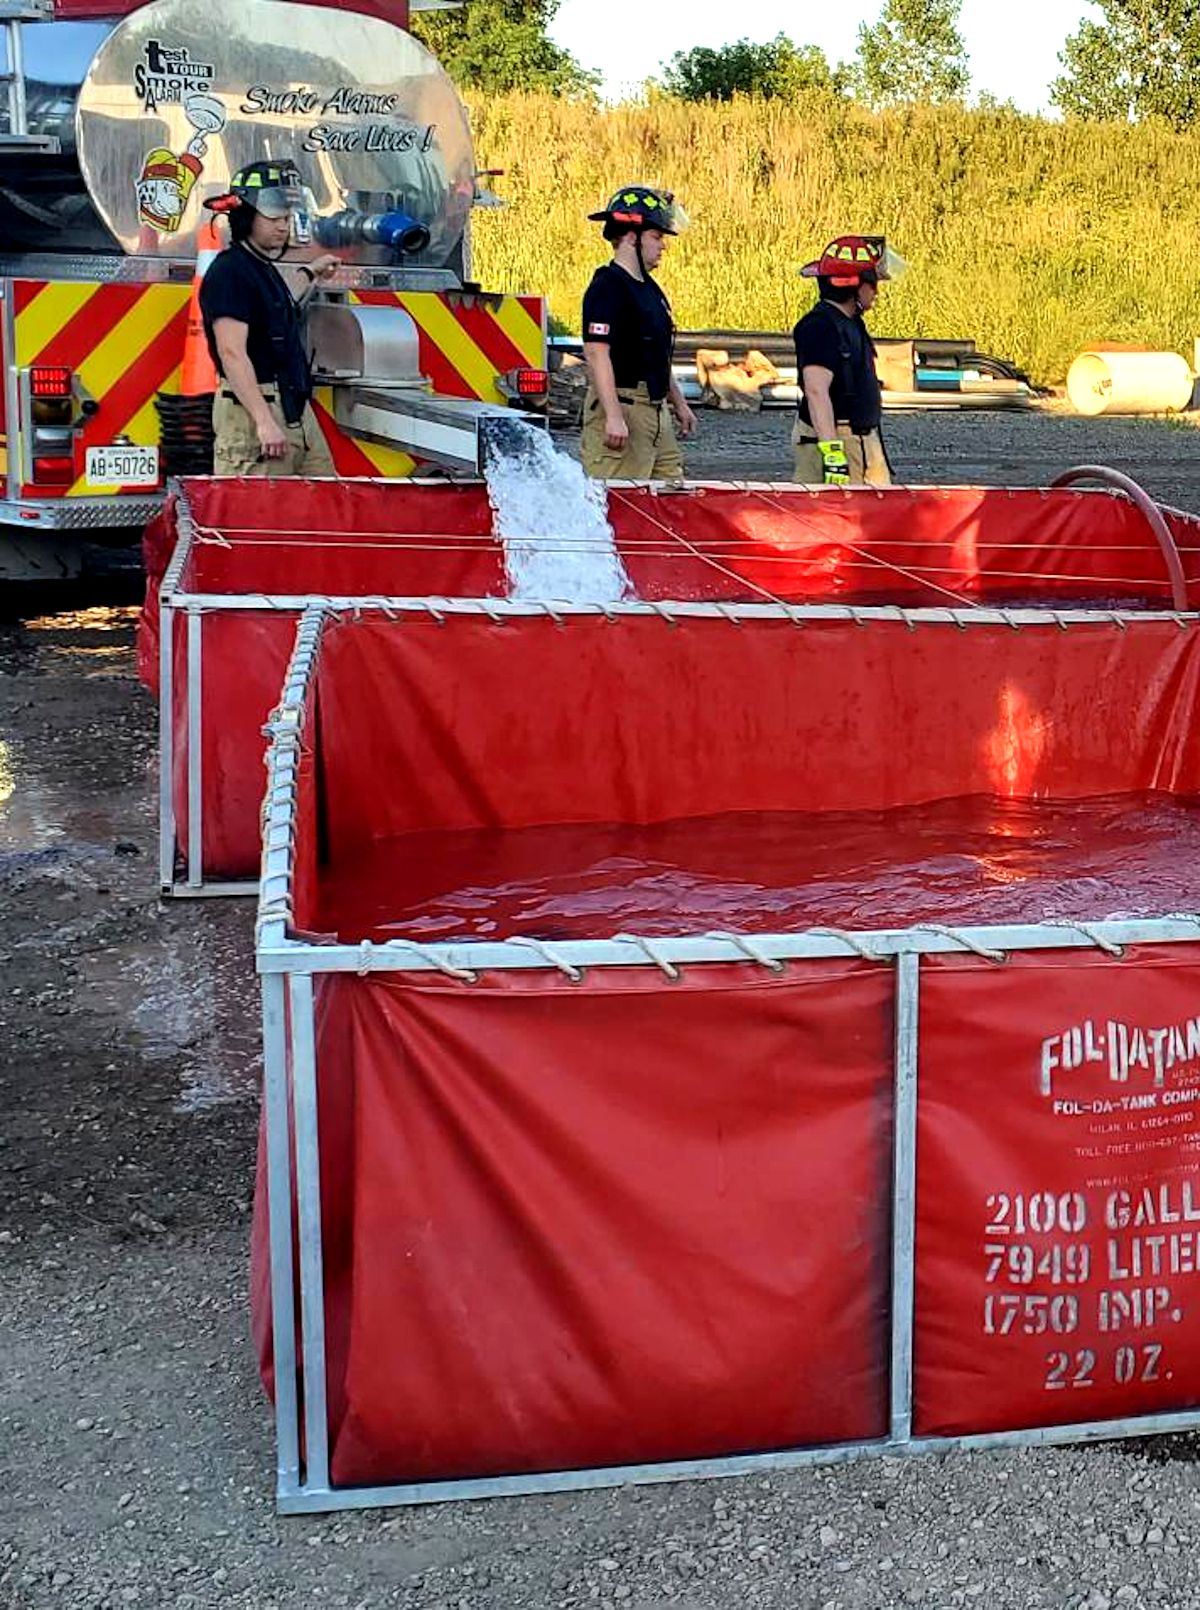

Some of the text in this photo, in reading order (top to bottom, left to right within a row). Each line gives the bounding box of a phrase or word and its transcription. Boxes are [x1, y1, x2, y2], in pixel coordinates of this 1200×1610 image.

[135, 64, 209, 98] Smoke
[171, 63, 209, 77] YOUR
[240, 85, 398, 115] Smoke Alarms
[303, 124, 360, 152] Save
[365, 125, 418, 152] Lives
[1053, 1093, 1157, 1115] FOL-DA-TANK
[1075, 1145, 1101, 1157] TOLL
[985, 1194, 1088, 1235] 2100
[984, 1242, 1091, 1284] 7949
[983, 1287, 1184, 1335] 1750 IMP.
[1043, 1344, 1174, 1389] 22 OZ.
